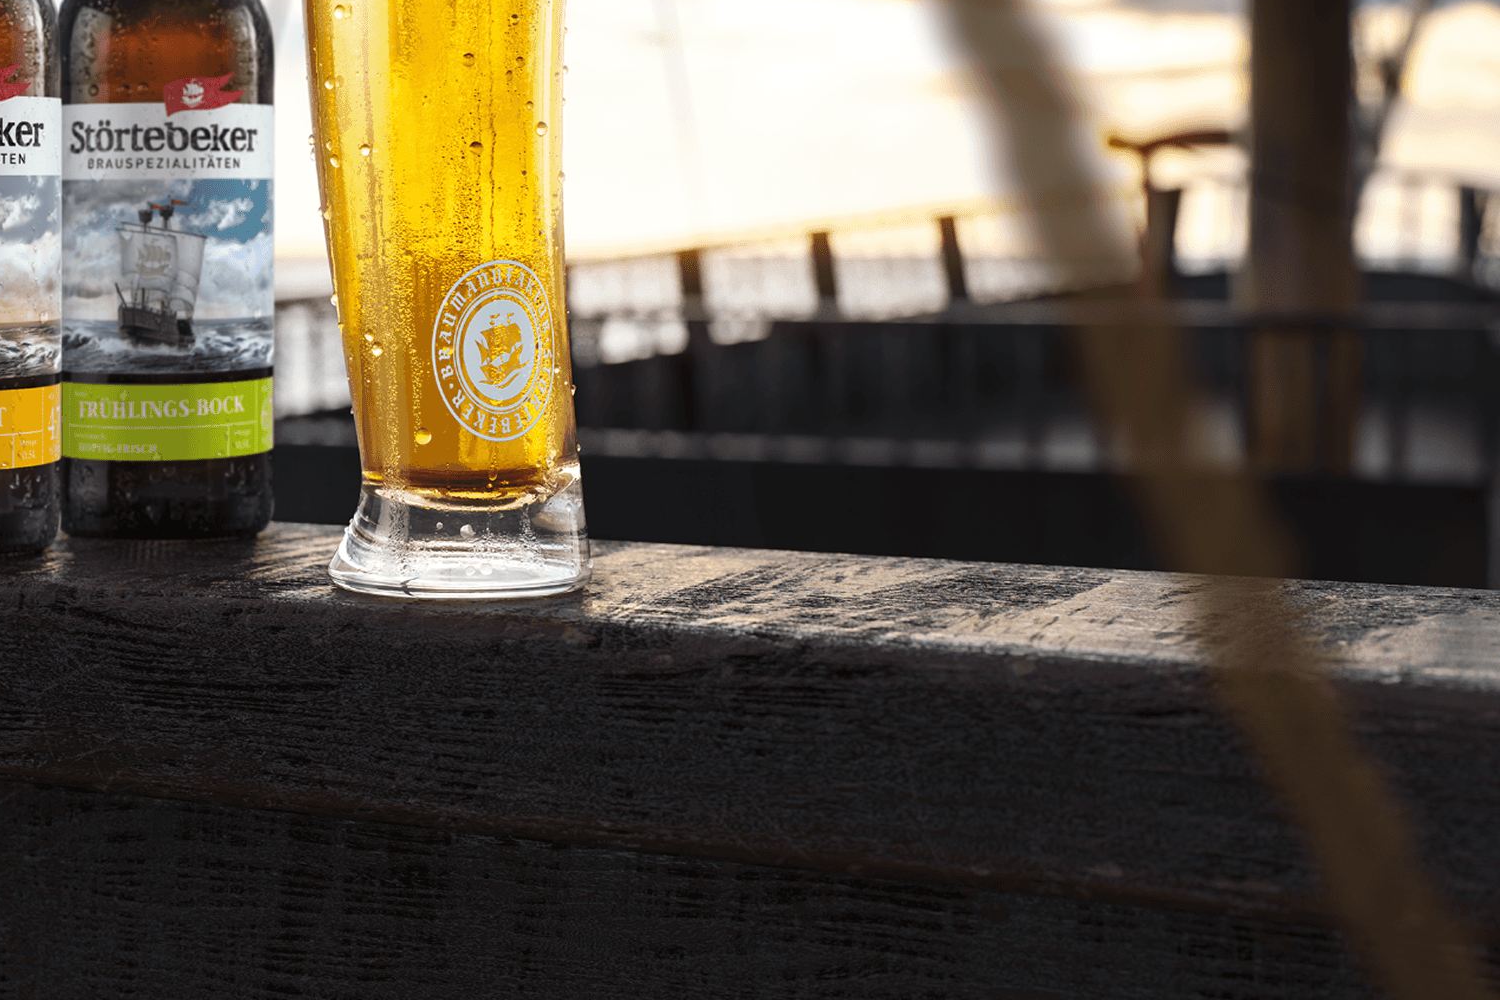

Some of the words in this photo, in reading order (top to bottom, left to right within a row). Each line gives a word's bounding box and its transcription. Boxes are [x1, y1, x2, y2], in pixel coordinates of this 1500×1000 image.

[69, 119, 259, 155] Störtebeker
[86, 155, 241, 170] BRAUSPEZIALITÄTEN
[78, 394, 245, 419] FRÜHLINGS-BOCK
